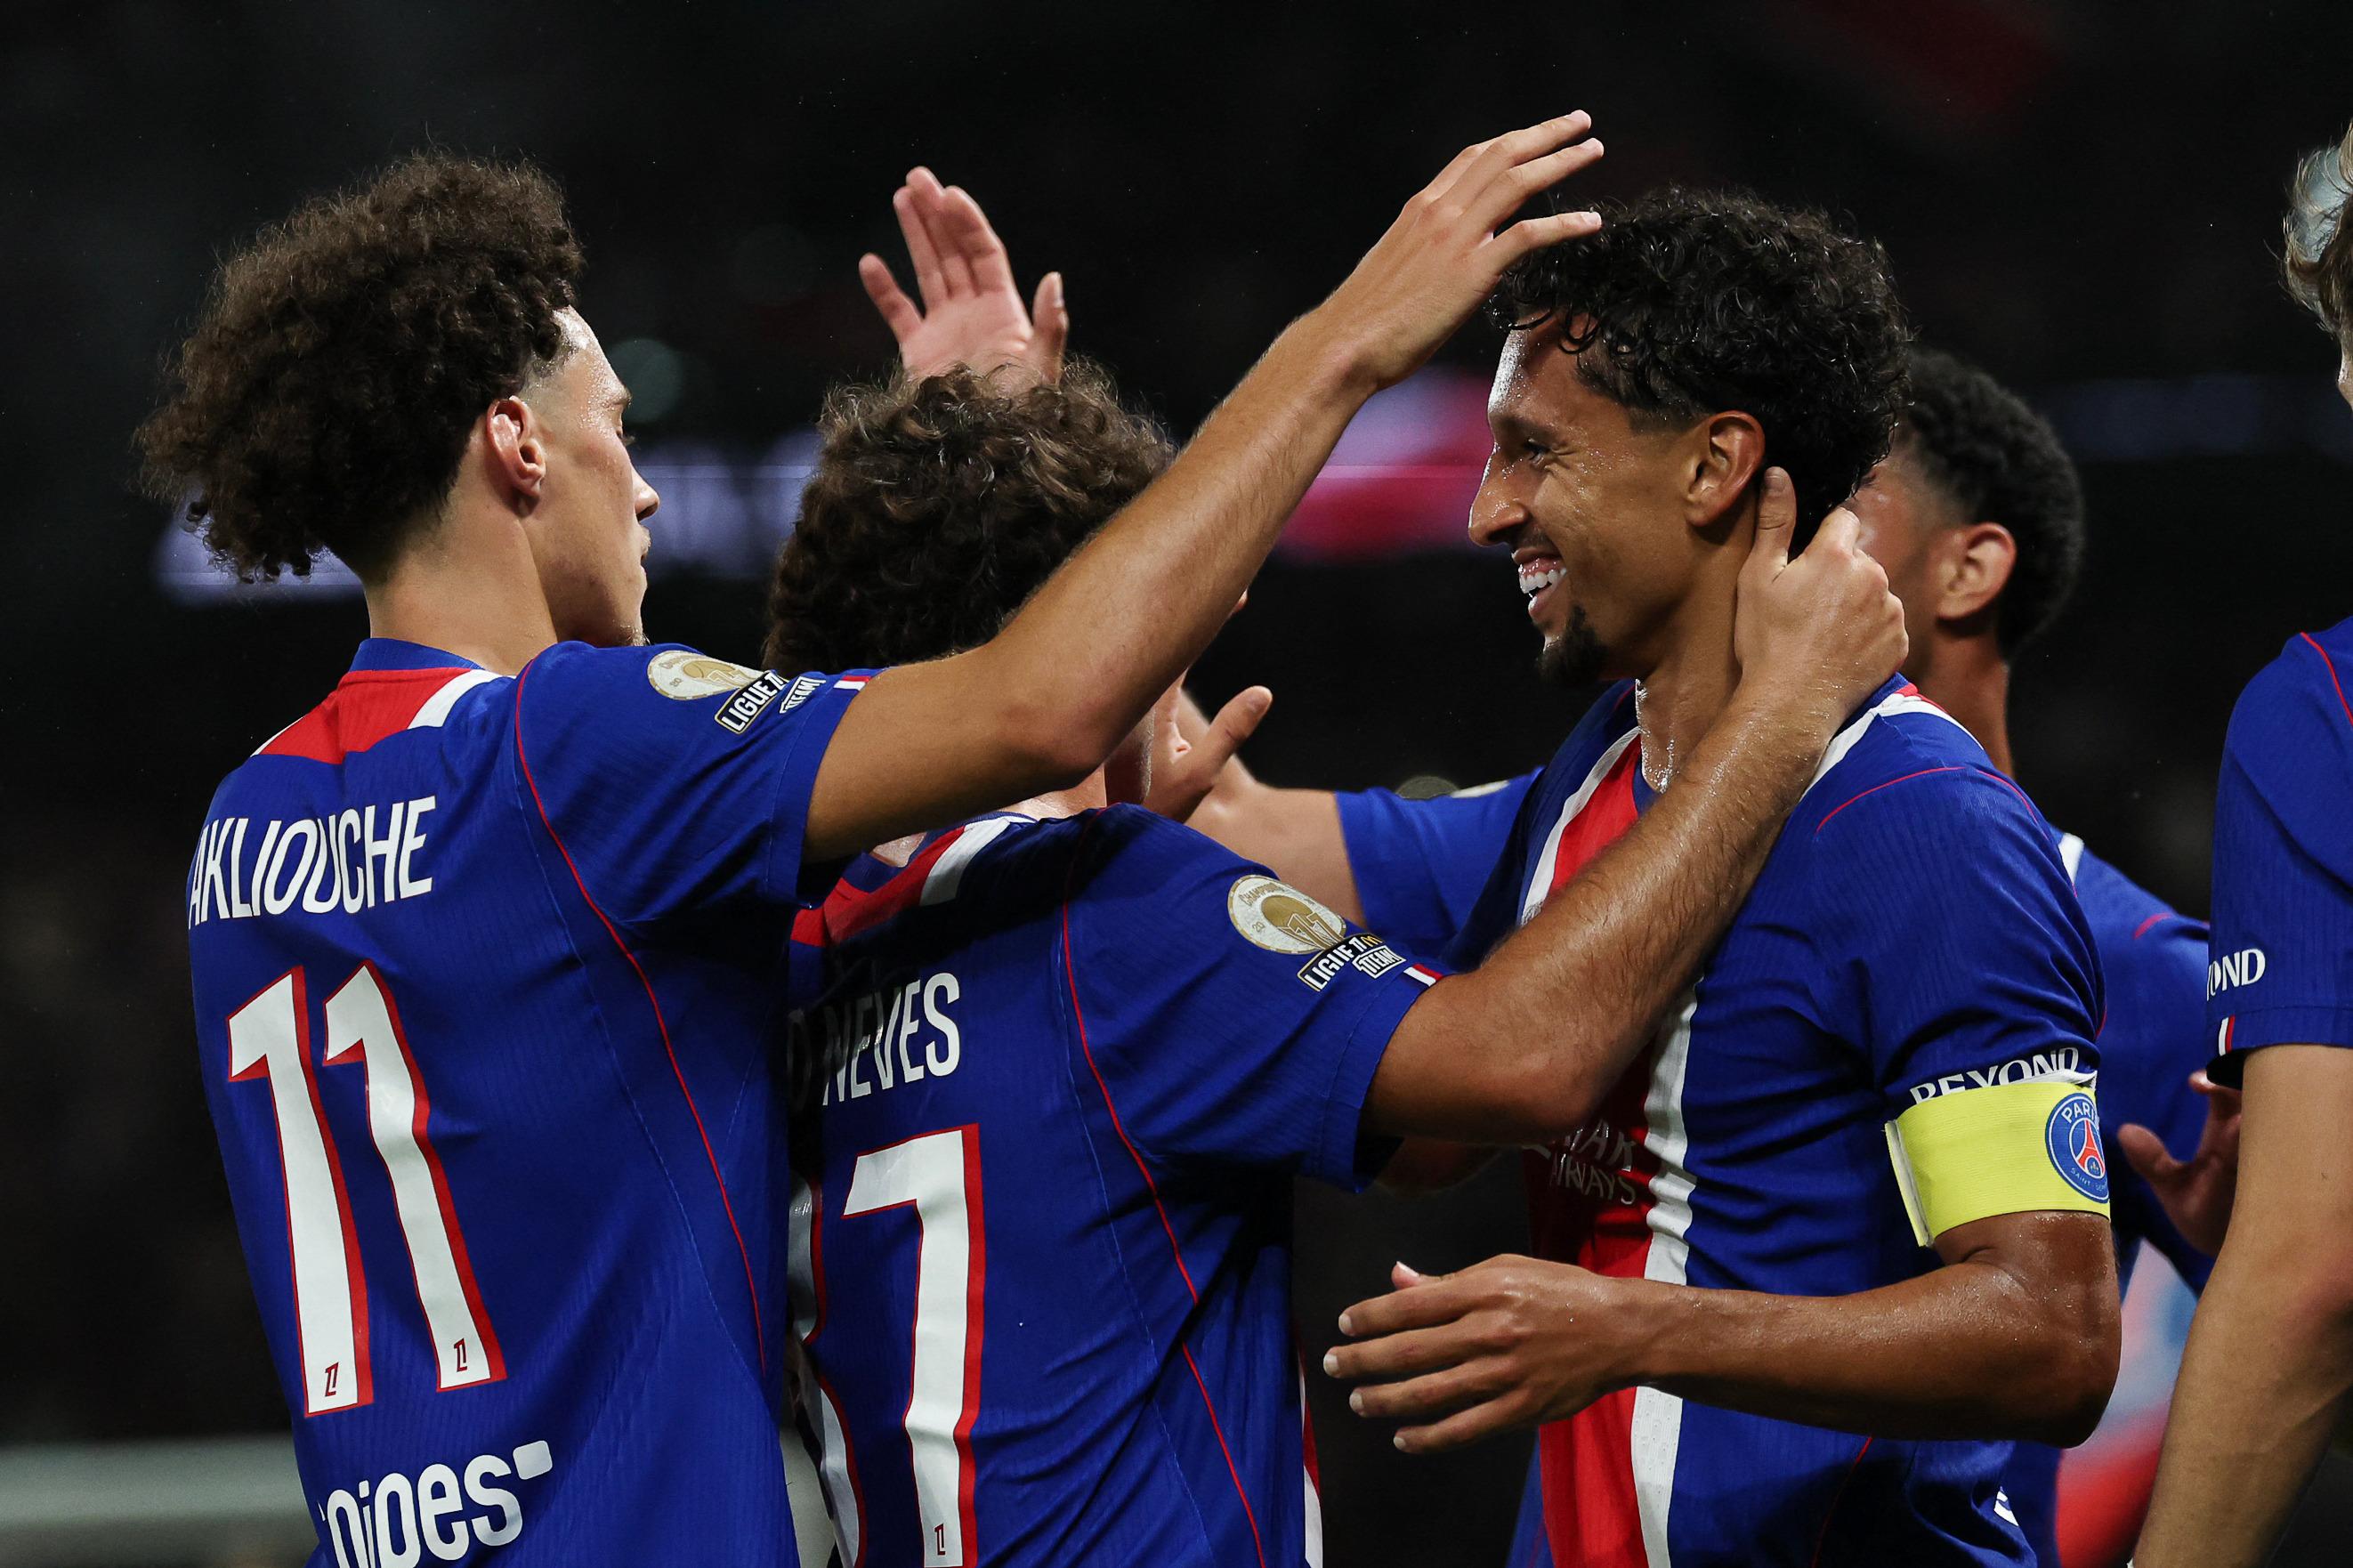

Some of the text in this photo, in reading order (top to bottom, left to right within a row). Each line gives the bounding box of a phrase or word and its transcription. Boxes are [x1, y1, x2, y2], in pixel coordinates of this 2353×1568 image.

[721, 681, 778, 731] LIGUE
[188, 796, 437, 930] AKLIOUCHE
[2206, 948, 2266, 1001] OND
[822, 972, 960, 1106] NEVES
[1909, 1047, 2079, 1104] BEYOND
[226, 958, 507, 1418] 11
[318, 1455, 523, 1568] nipes
